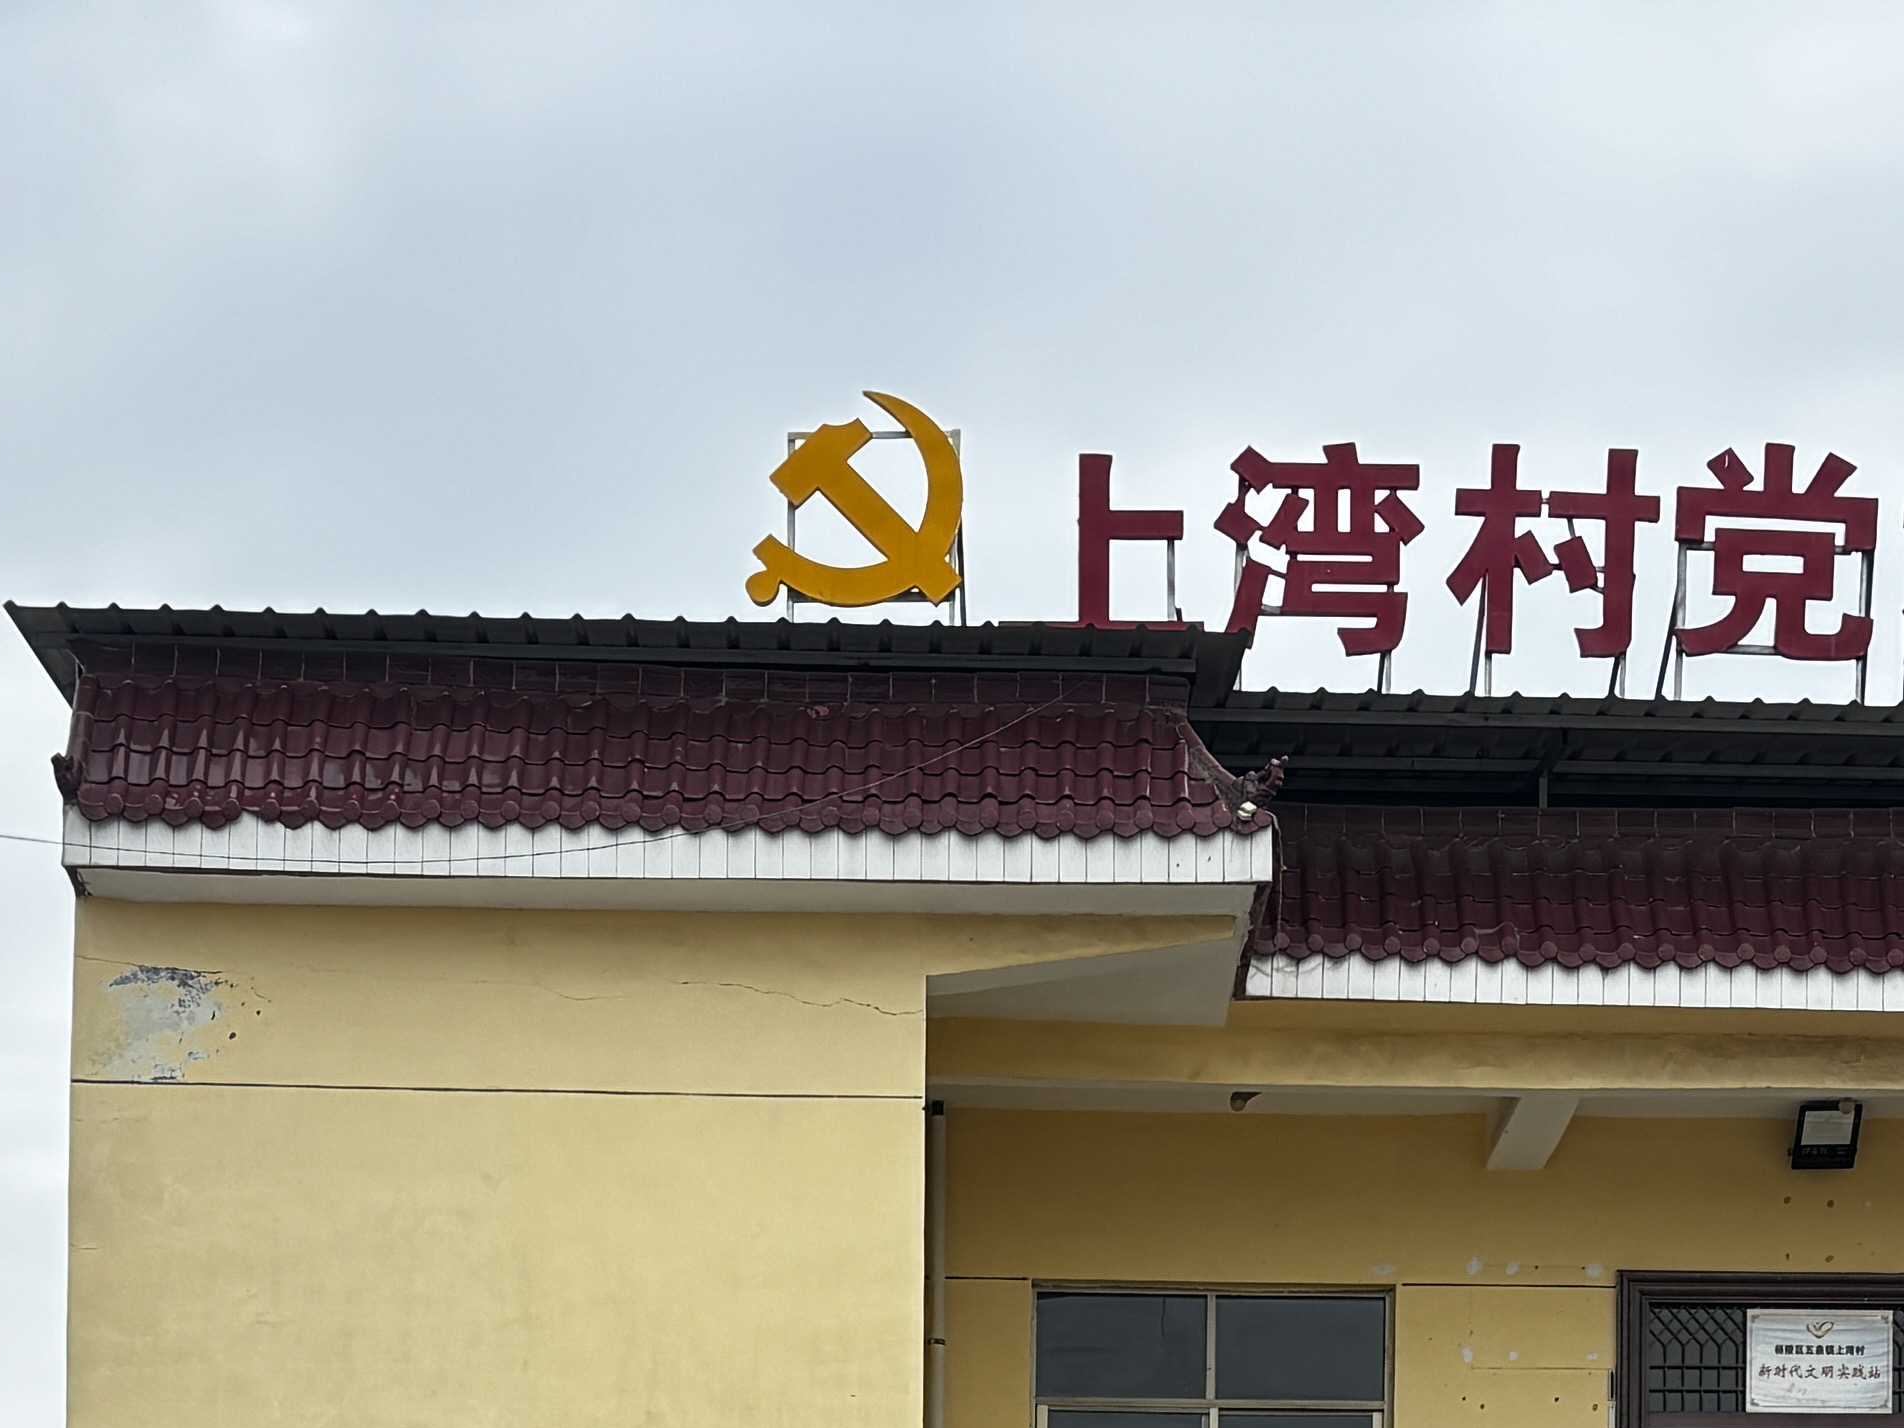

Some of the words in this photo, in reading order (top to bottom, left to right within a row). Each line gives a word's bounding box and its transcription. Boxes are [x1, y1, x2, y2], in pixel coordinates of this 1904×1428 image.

[1758, 1363, 1881, 1380] 新时代文明实践站
